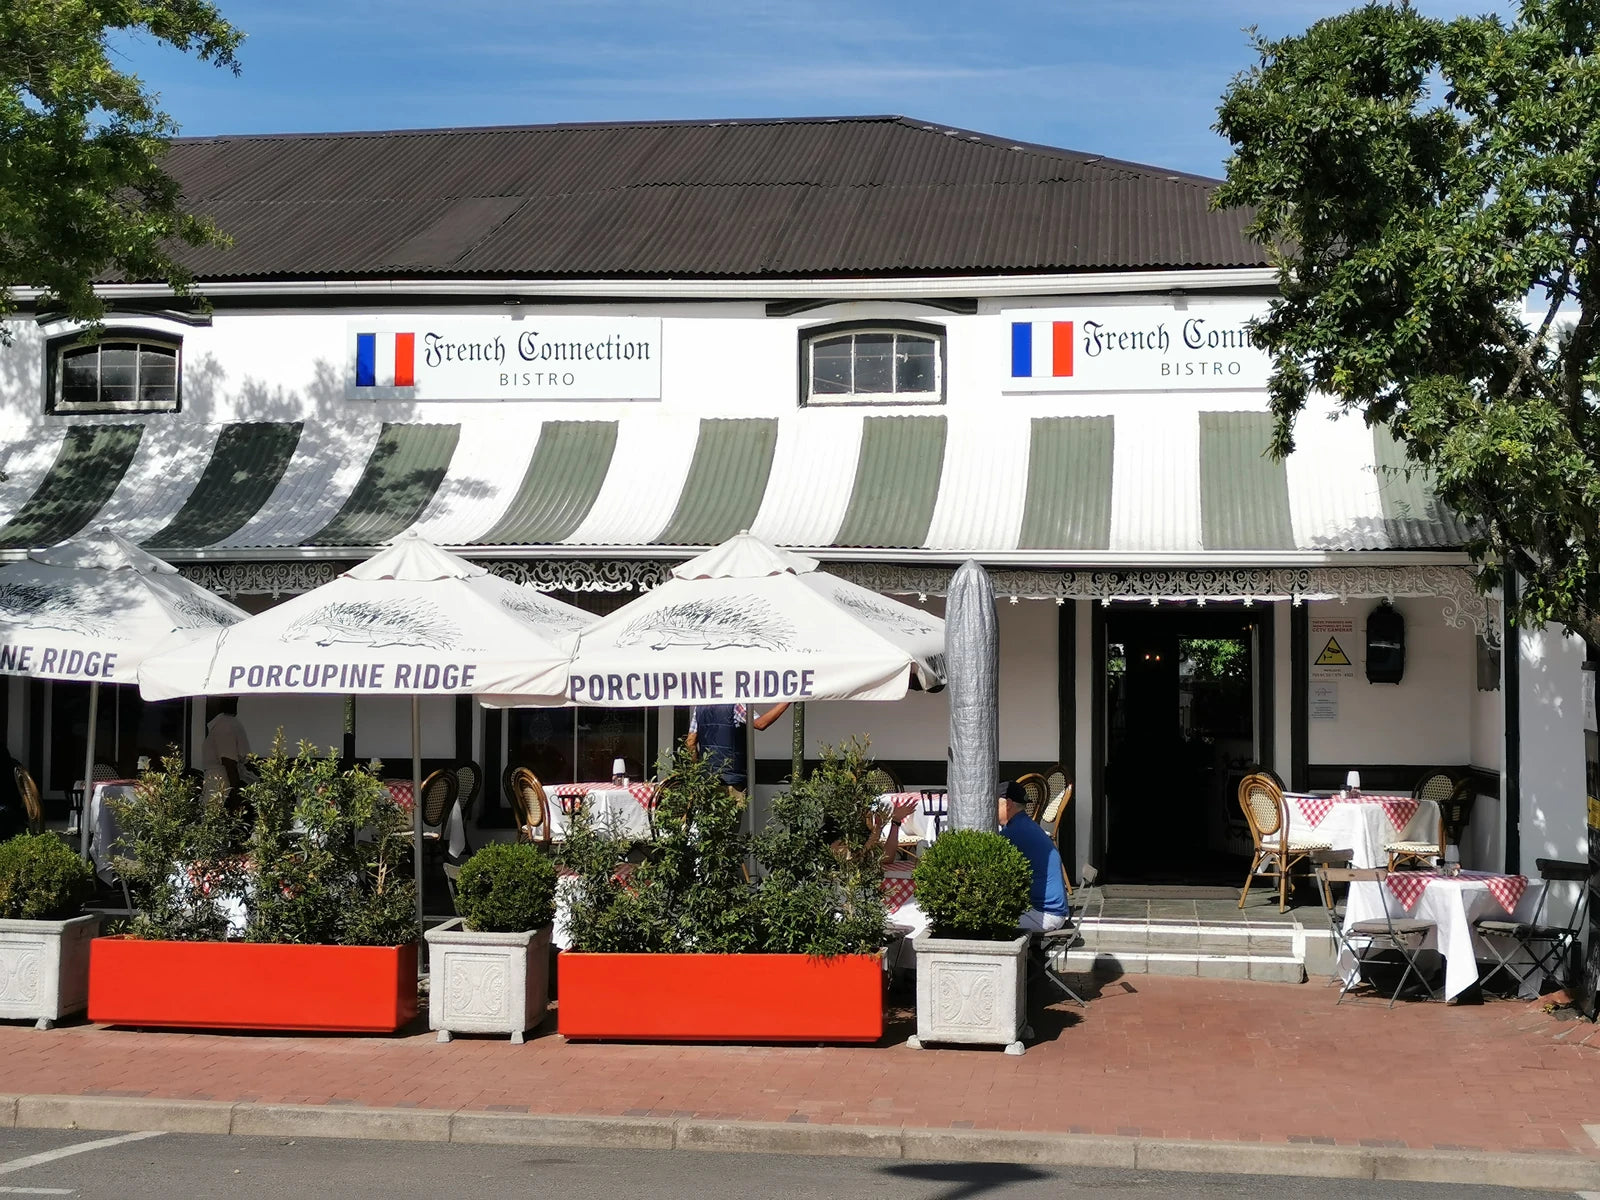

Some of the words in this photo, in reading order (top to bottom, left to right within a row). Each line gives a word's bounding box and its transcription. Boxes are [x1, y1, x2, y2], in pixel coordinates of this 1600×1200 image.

[424, 331, 506, 368] French
[517, 331, 651, 362] Connection
[1083, 320, 1170, 358] French
[1182, 318, 1253, 350] Conn
[499, 372, 575, 386] BISTRO
[1161, 361, 1241, 376] BISTRO
[40, 647, 118, 678] RIDGE
[229, 664, 384, 689] PORCUPINE
[394, 663, 477, 690] RIDGE
[569, 671, 724, 701] PORCUPINE
[735, 669, 815, 698] RIDGE
